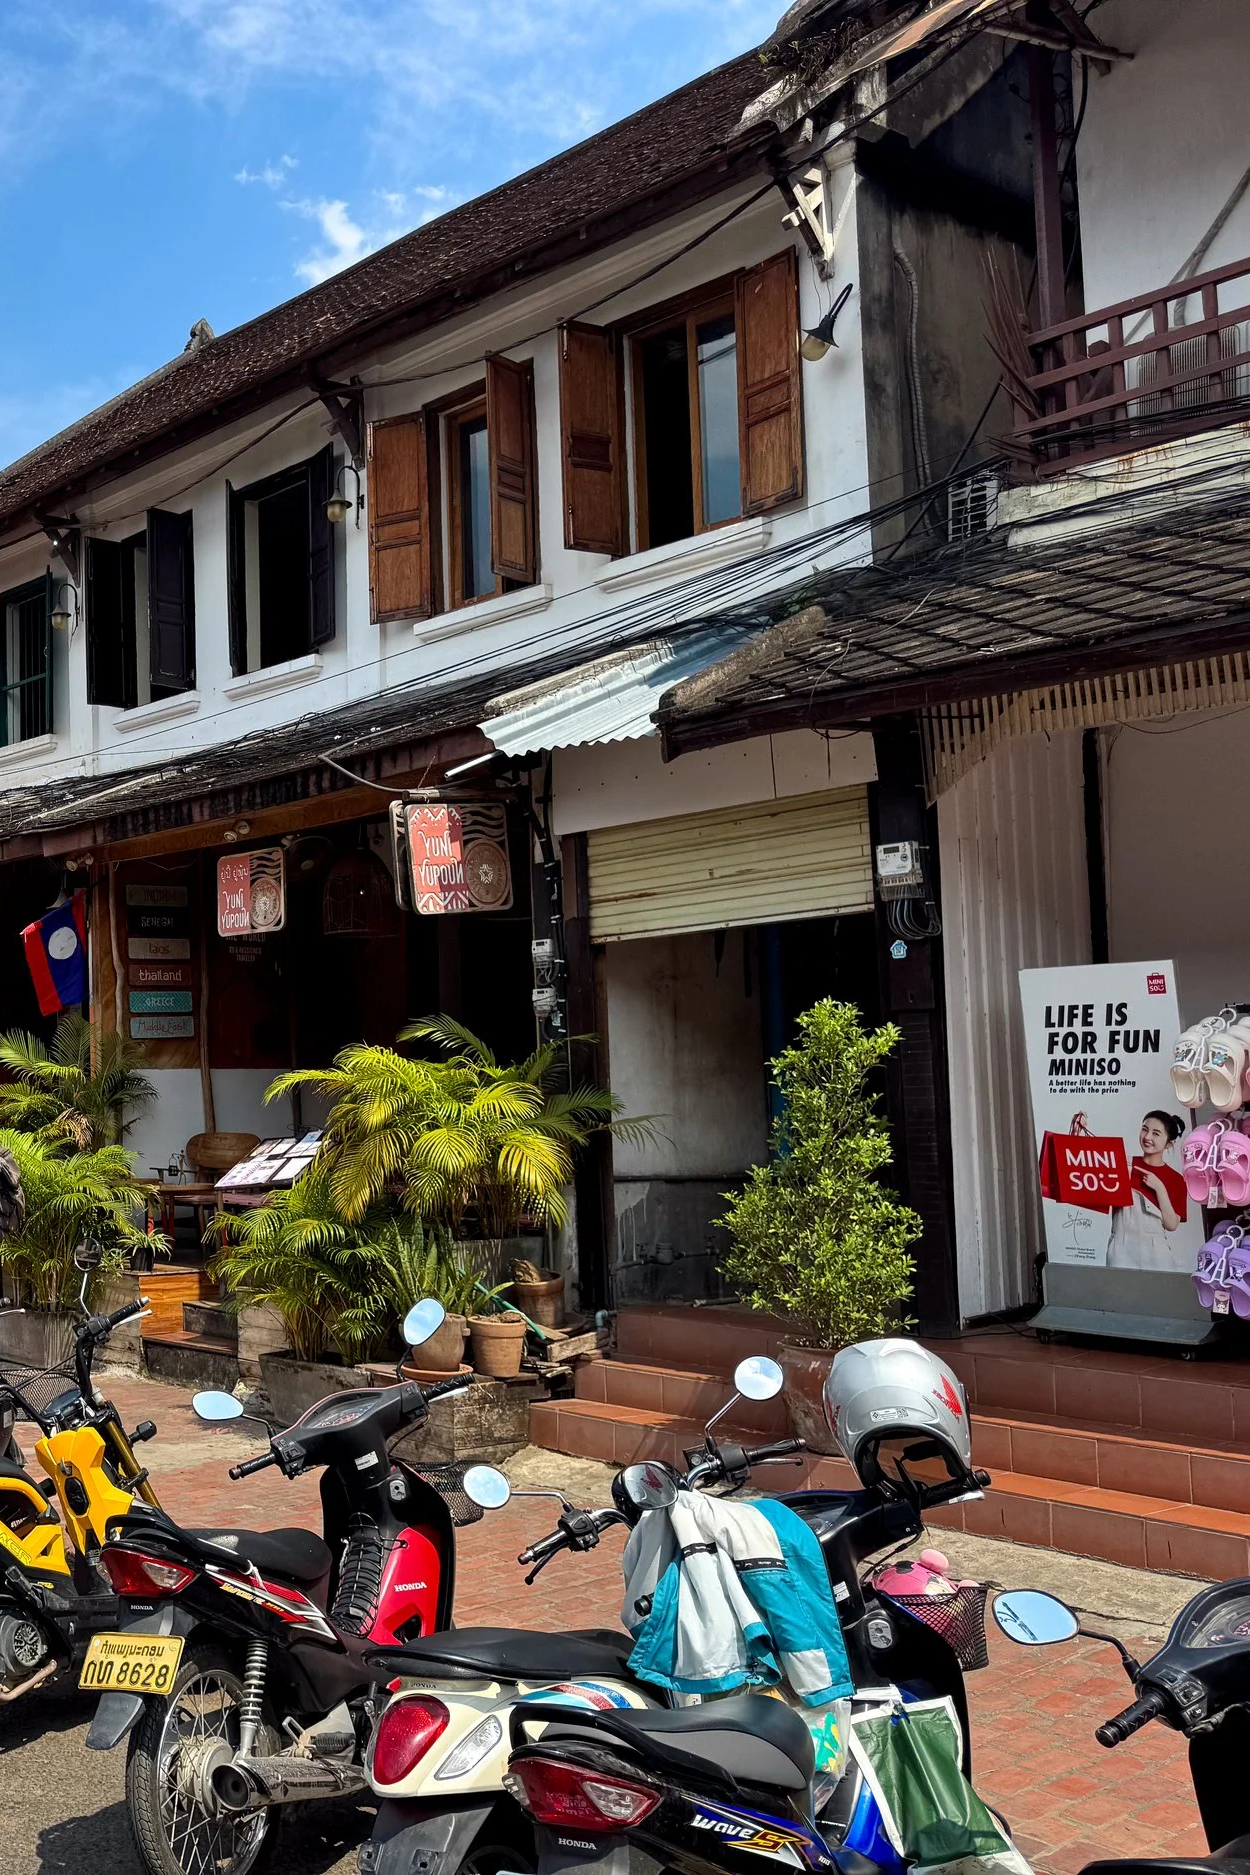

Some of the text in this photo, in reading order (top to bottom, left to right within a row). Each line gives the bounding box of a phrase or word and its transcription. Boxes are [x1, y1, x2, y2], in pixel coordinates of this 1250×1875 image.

[417, 830, 452, 857] YUNI
[418, 857, 464, 887] YUPOUN
[222, 888, 244, 909] YUNI
[221, 907, 250, 930] YUPOUN
[138, 969, 183, 982] thailand
[1044, 1002, 1128, 1029] LIFE IS
[1047, 1029, 1161, 1055] FOR FUN
[1048, 1057, 1121, 1077] MINISO
[1069, 1086, 1086, 1094] with
[1087, 1086, 1100, 1094] the
[1101, 1086, 1120, 1096] price
[1079, 1079, 1092, 1087] life
[1093, 1079, 1107, 1087] has
[1108, 1079, 1137, 1088] nothing
[1065, 1147, 1117, 1170] MINI
[394, 1581, 428, 1592] HONDA
[116, 1661, 170, 1689] 8628
[558, 1837, 597, 1850] HONDA
[818, 1855, 831, 1867] 100
